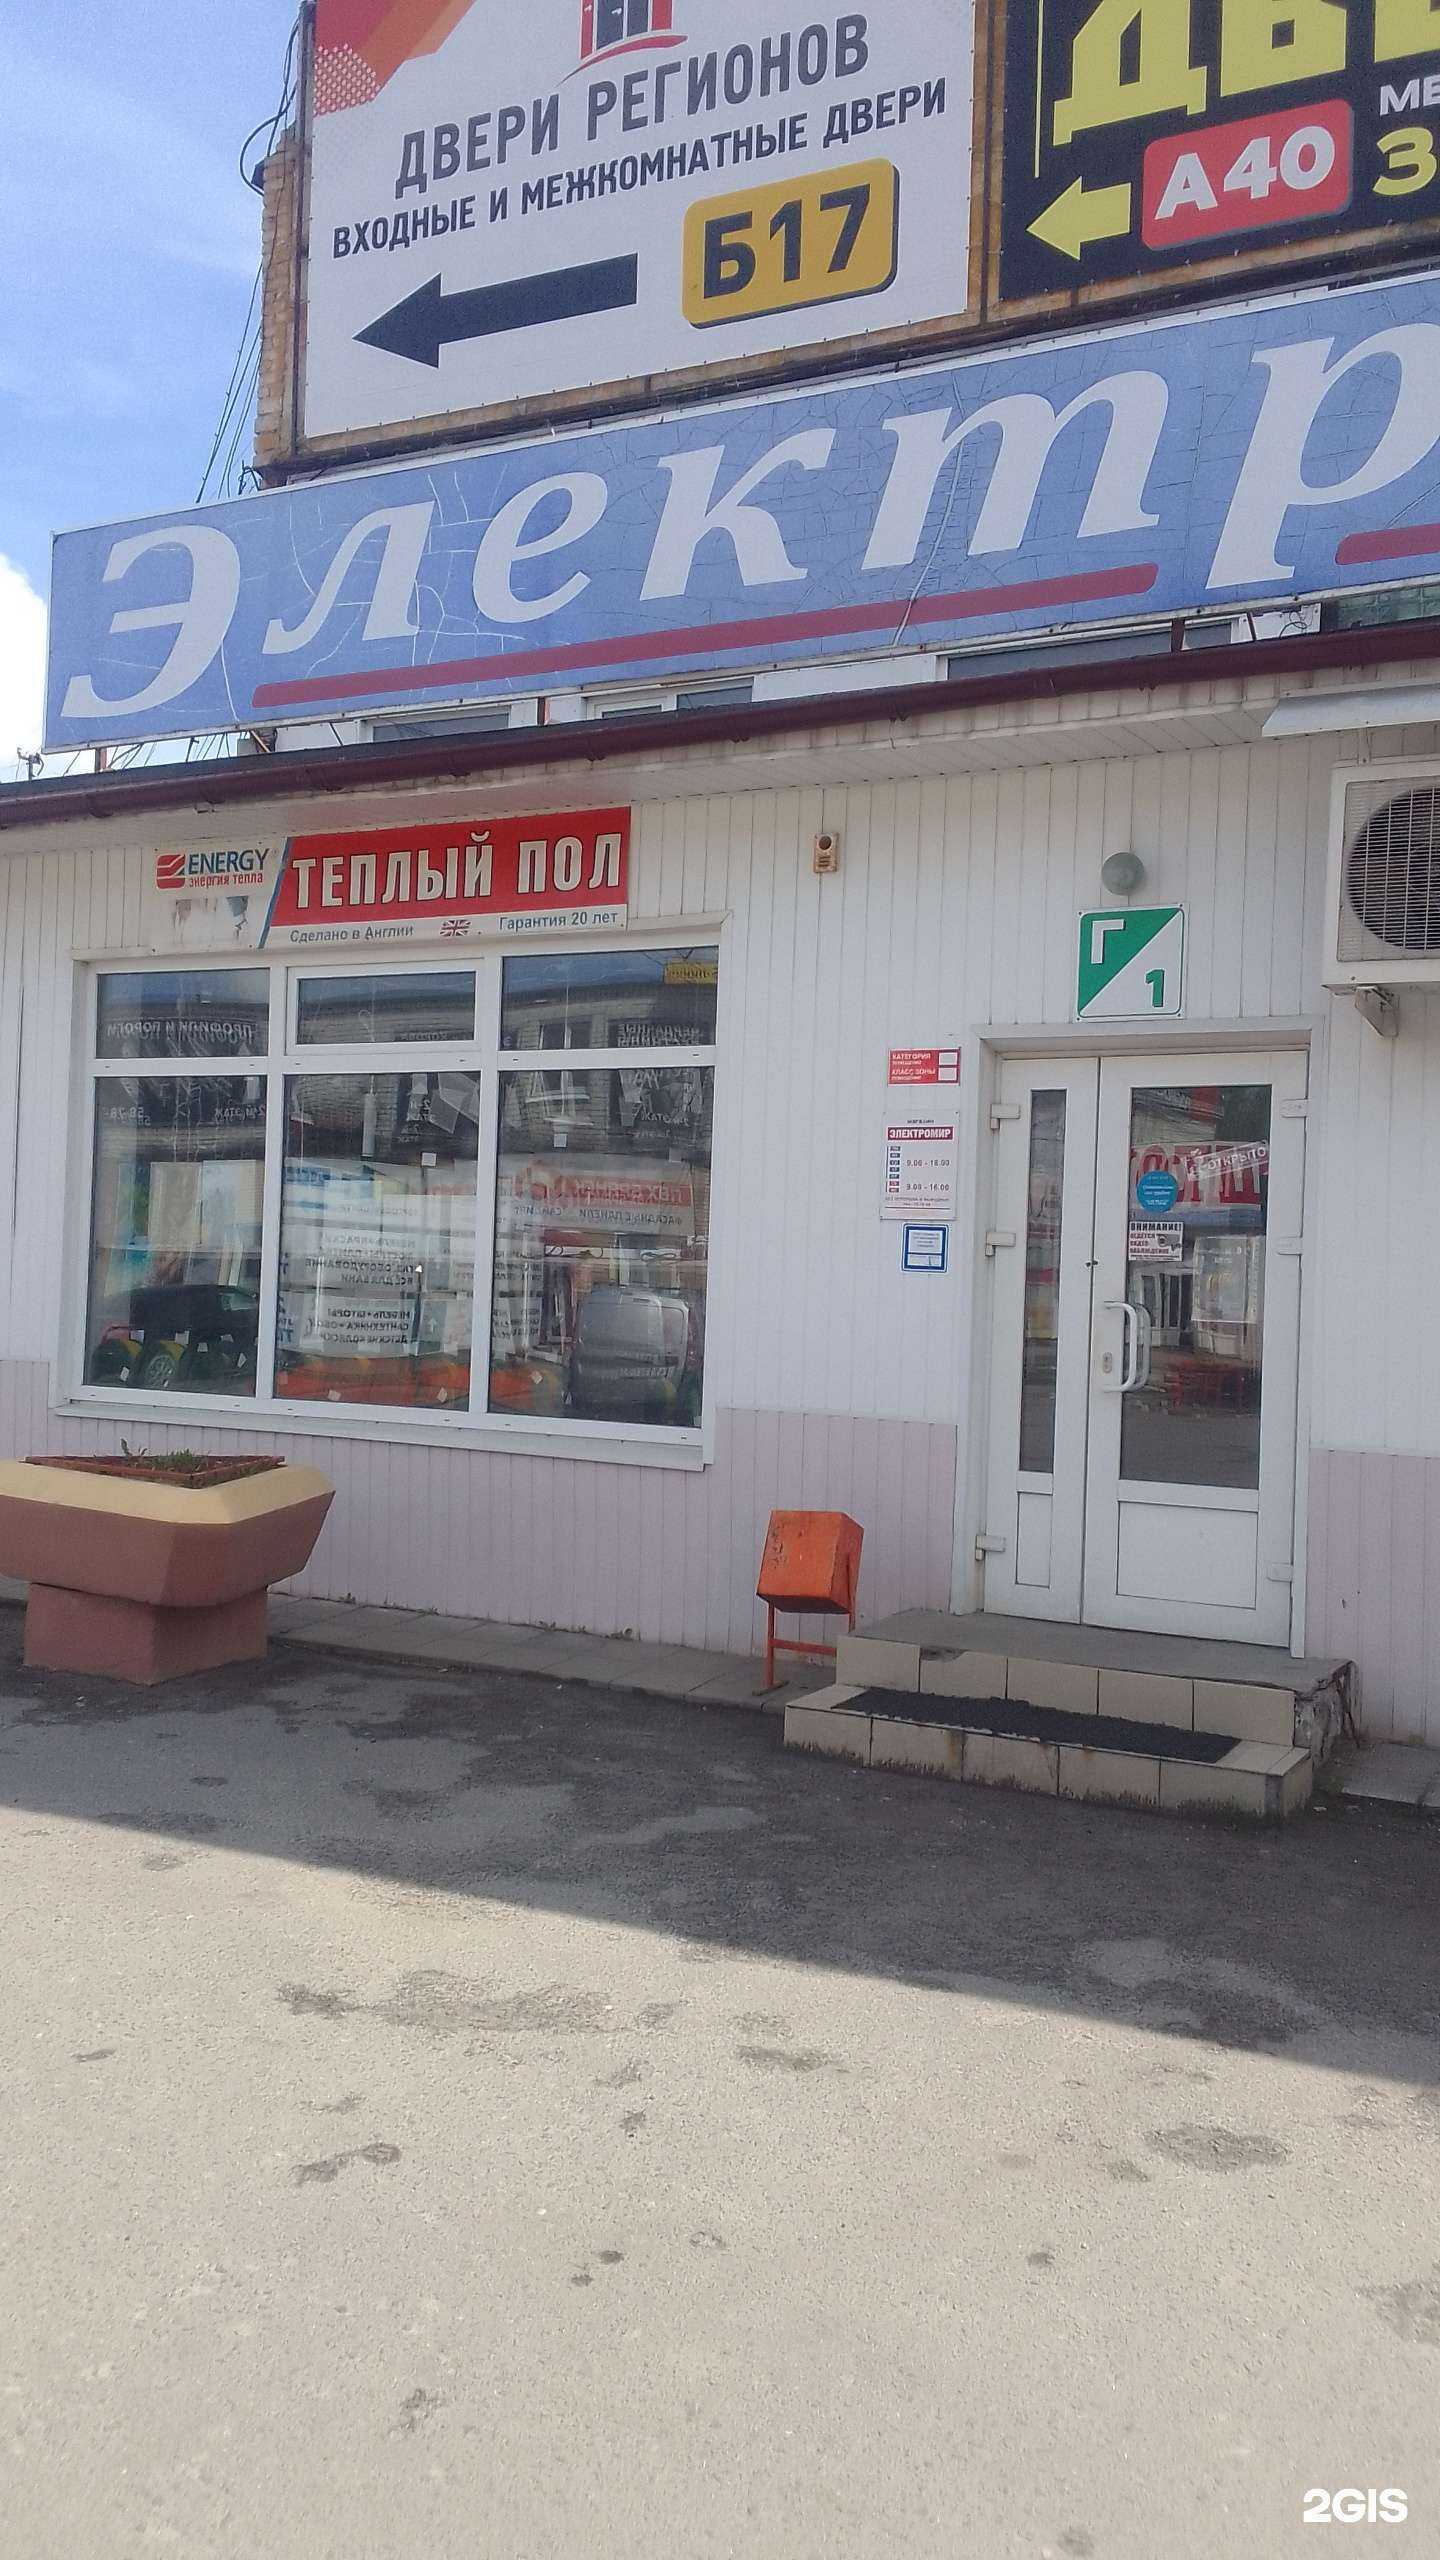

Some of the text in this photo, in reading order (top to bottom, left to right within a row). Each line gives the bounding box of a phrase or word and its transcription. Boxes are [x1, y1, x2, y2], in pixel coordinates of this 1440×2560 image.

[395, 13, 870, 199] ДВЕРИ РЕГИОНОВ
[332, 77, 947, 259] ВХОДНЫЕ И МЕЖКОМНАТНЫЕ ДВЕРИ
[1154, 125, 1335, 221] А40
[702, 183, 871, 299] Б17
[60, 322, 1440, 719] Электр
[188, 848, 270, 876] ENERGY
[189, 872, 263, 889] энергия тепла
[292, 830, 623, 910] ТЕПЛЫЙ ПОЛ
[290, 925, 414, 945] Сделано в Англии
[500, 911, 618, 934] Гарантия 20 лет
[1091, 919, 1125, 964] Г
[1145, 969, 1165, 1008] 1
[889, 1129, 951, 1138] ЭЛЕКТРОМИР
[1207, 1147, 1266, 1170] ОТКРЫТО
[1130, 1222, 1182, 1231] ВНИМАНИЕ!
